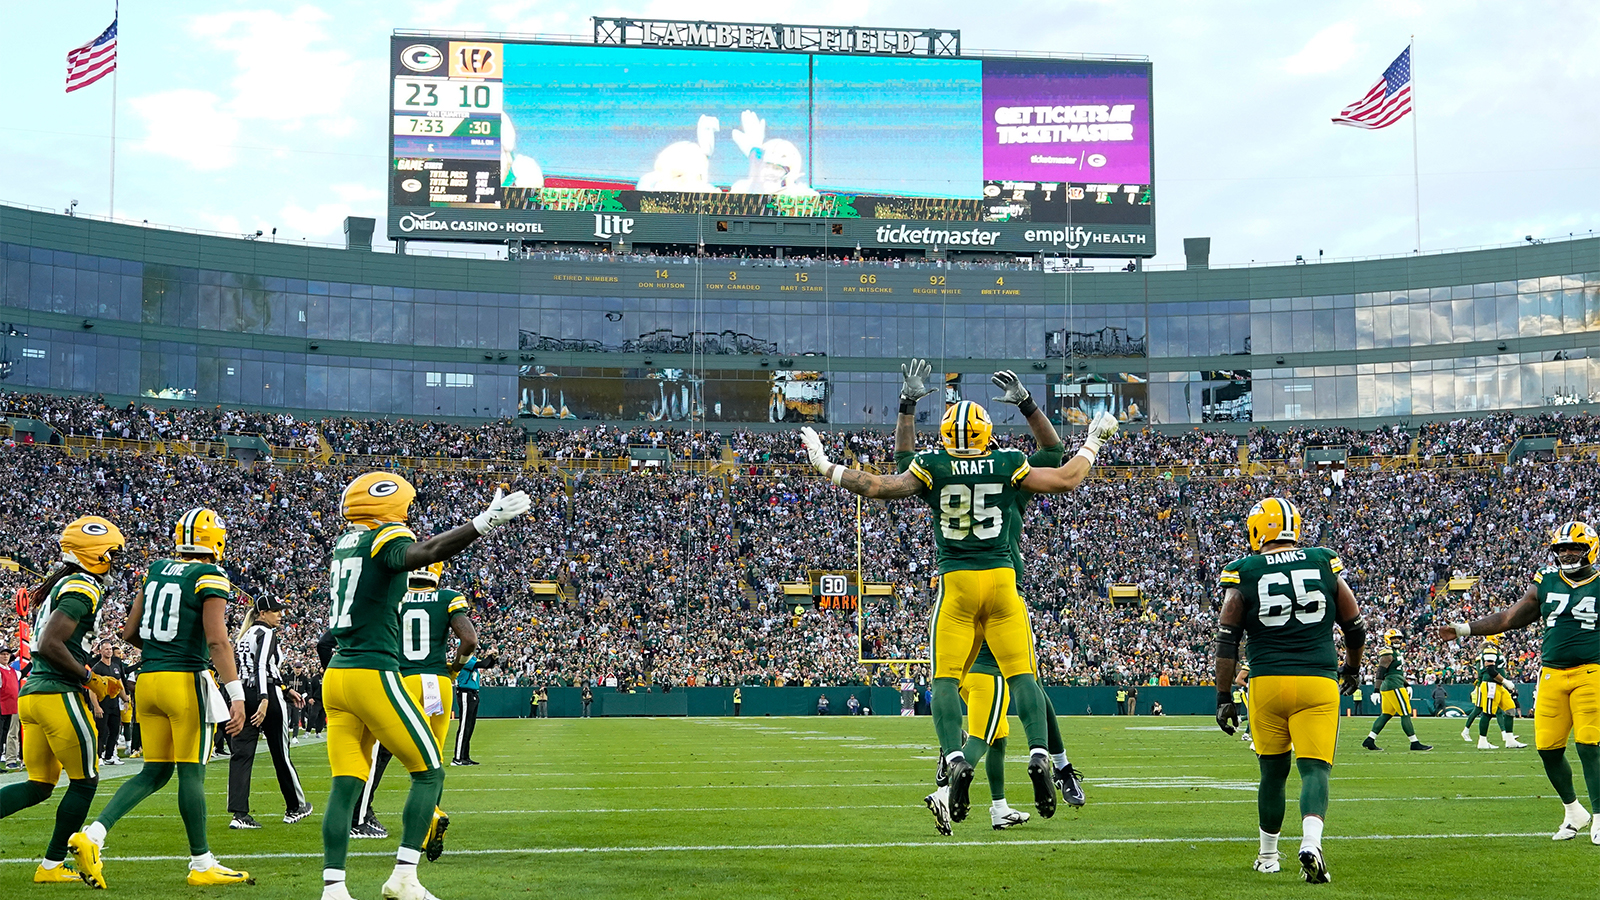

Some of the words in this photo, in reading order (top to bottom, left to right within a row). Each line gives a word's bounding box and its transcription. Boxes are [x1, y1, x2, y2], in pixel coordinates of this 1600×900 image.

[642, 22, 802, 49] LAMBEAU
[819, 28, 916, 53] FIELD
[406, 83, 438, 106] 23
[459, 85, 490, 108] 10
[995, 107, 1033, 125] GET
[1034, 105, 1109, 124] TICKETS
[1109, 104, 1135, 122] AT
[409, 118, 444, 133] 7:33
[469, 121, 491, 135] :30
[996, 123, 1133, 144] TICKETMASTER
[398, 160, 424, 171] GAME
[1030, 155, 1077, 165] ticketmaster
[399, 214, 449, 232] ONEIDA
[450, 221, 497, 232] CASINO
[506, 223, 544, 233] HOTEL
[594, 213, 634, 239] Lite
[876, 225, 1000, 246] ticketmaster
[1024, 226, 1092, 248] emplify
[1093, 233, 1146, 244] HEALTH
[655, 269, 669, 279] 14
[729, 271, 737, 281] 3
[794, 272, 808, 282] 15
[860, 274, 876, 284] 66
[930, 275, 945, 286] 92
[996, 276, 1004, 286] 4
[950, 459, 995, 475] KRAFT
[939, 483, 1004, 540] 85
[1265, 550, 1307, 565] BANKS
[825, 578, 843, 593] 30
[820, 595, 858, 610] MARK
[1257, 568, 1326, 627] 65
[139, 581, 182, 642] 10
[1545, 592, 1598, 630] 74
[403, 608, 430, 661] 0
[239, 641, 250, 653] 53
